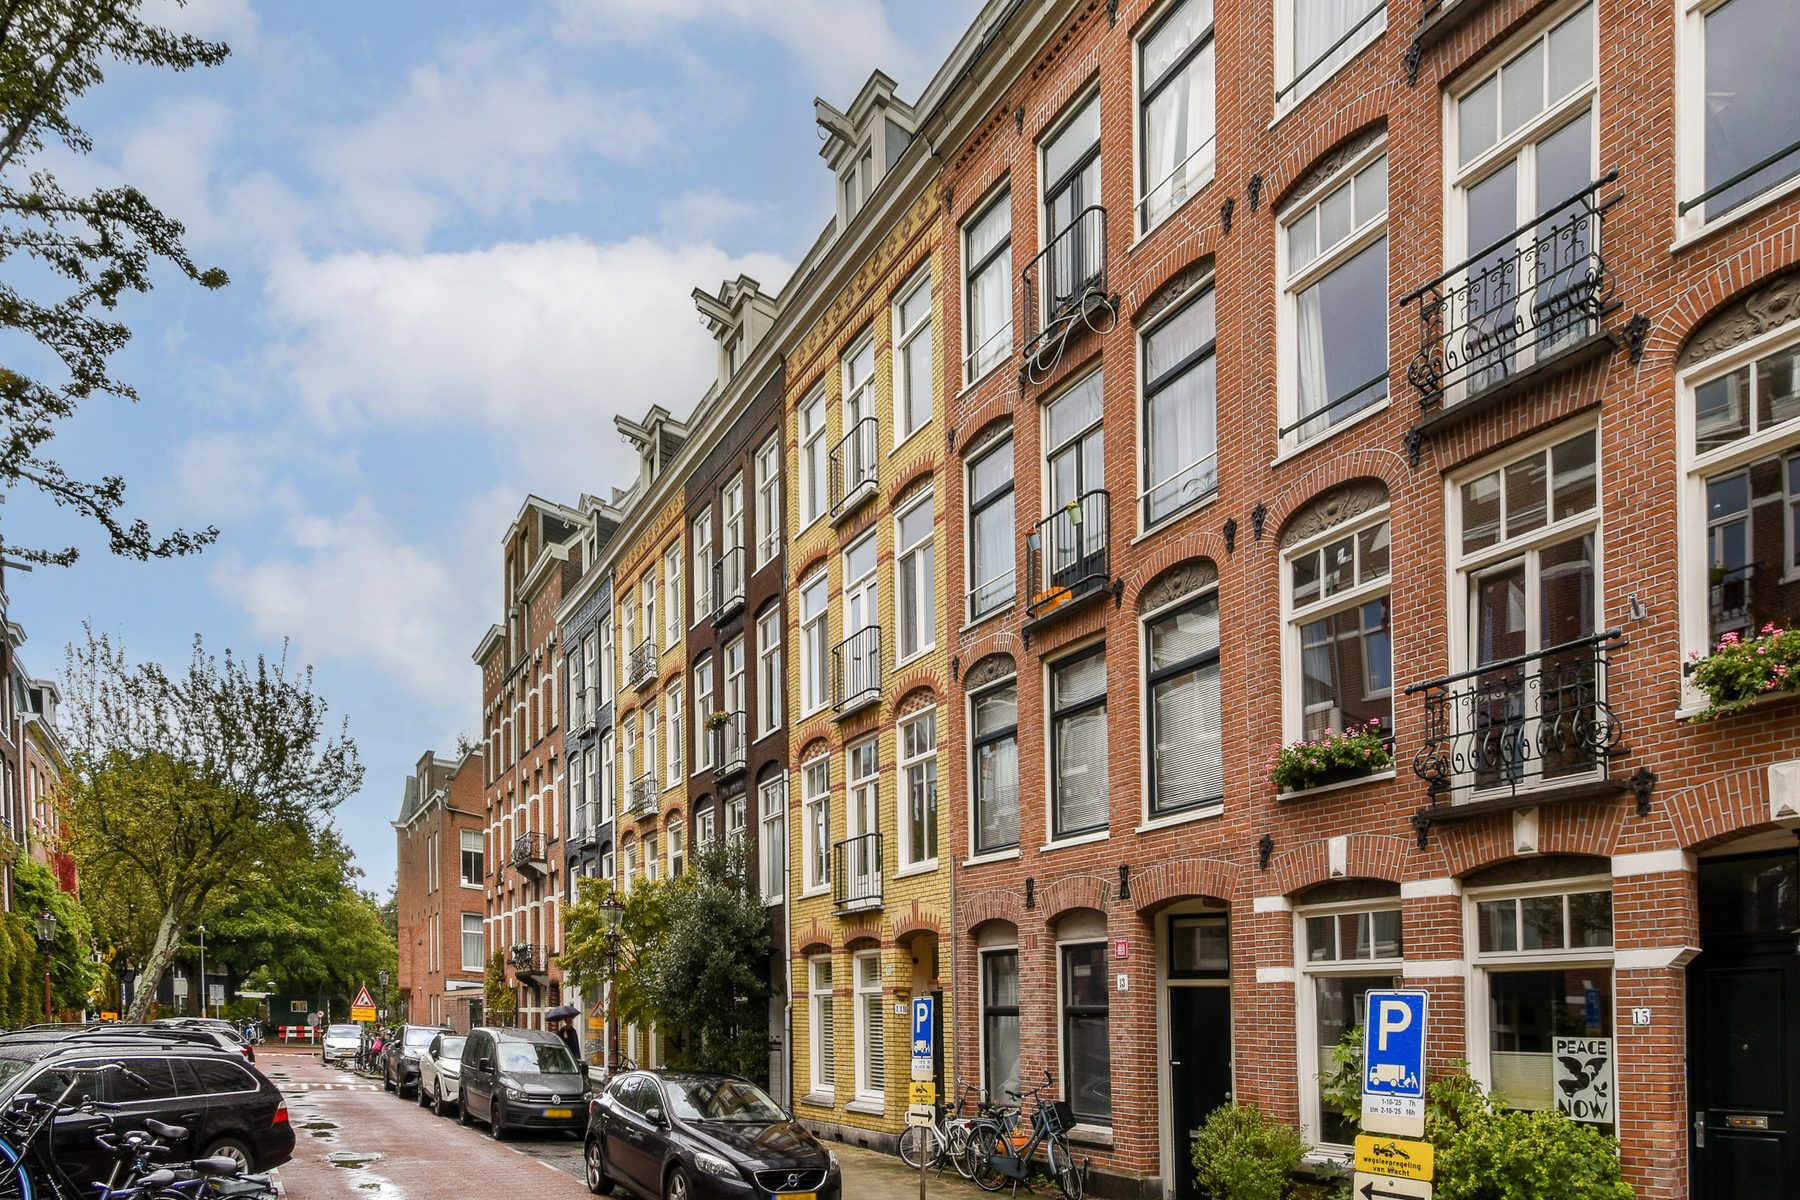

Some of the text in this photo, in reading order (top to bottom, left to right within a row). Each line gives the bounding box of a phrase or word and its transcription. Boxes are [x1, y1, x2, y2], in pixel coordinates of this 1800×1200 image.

[1119, 977, 1126, 988] 13
[916, 1003, 928, 1033] P
[1634, 1010, 1649, 1024] 15
[1378, 1000, 1412, 1051] P
[1557, 1040, 1607, 1055] PEACE
[1380, 1106, 1402, 1115] 2-10-'25
[1558, 1098, 1608, 1119] NOW
[1363, 1156, 1421, 1171] wegsleepregeling
